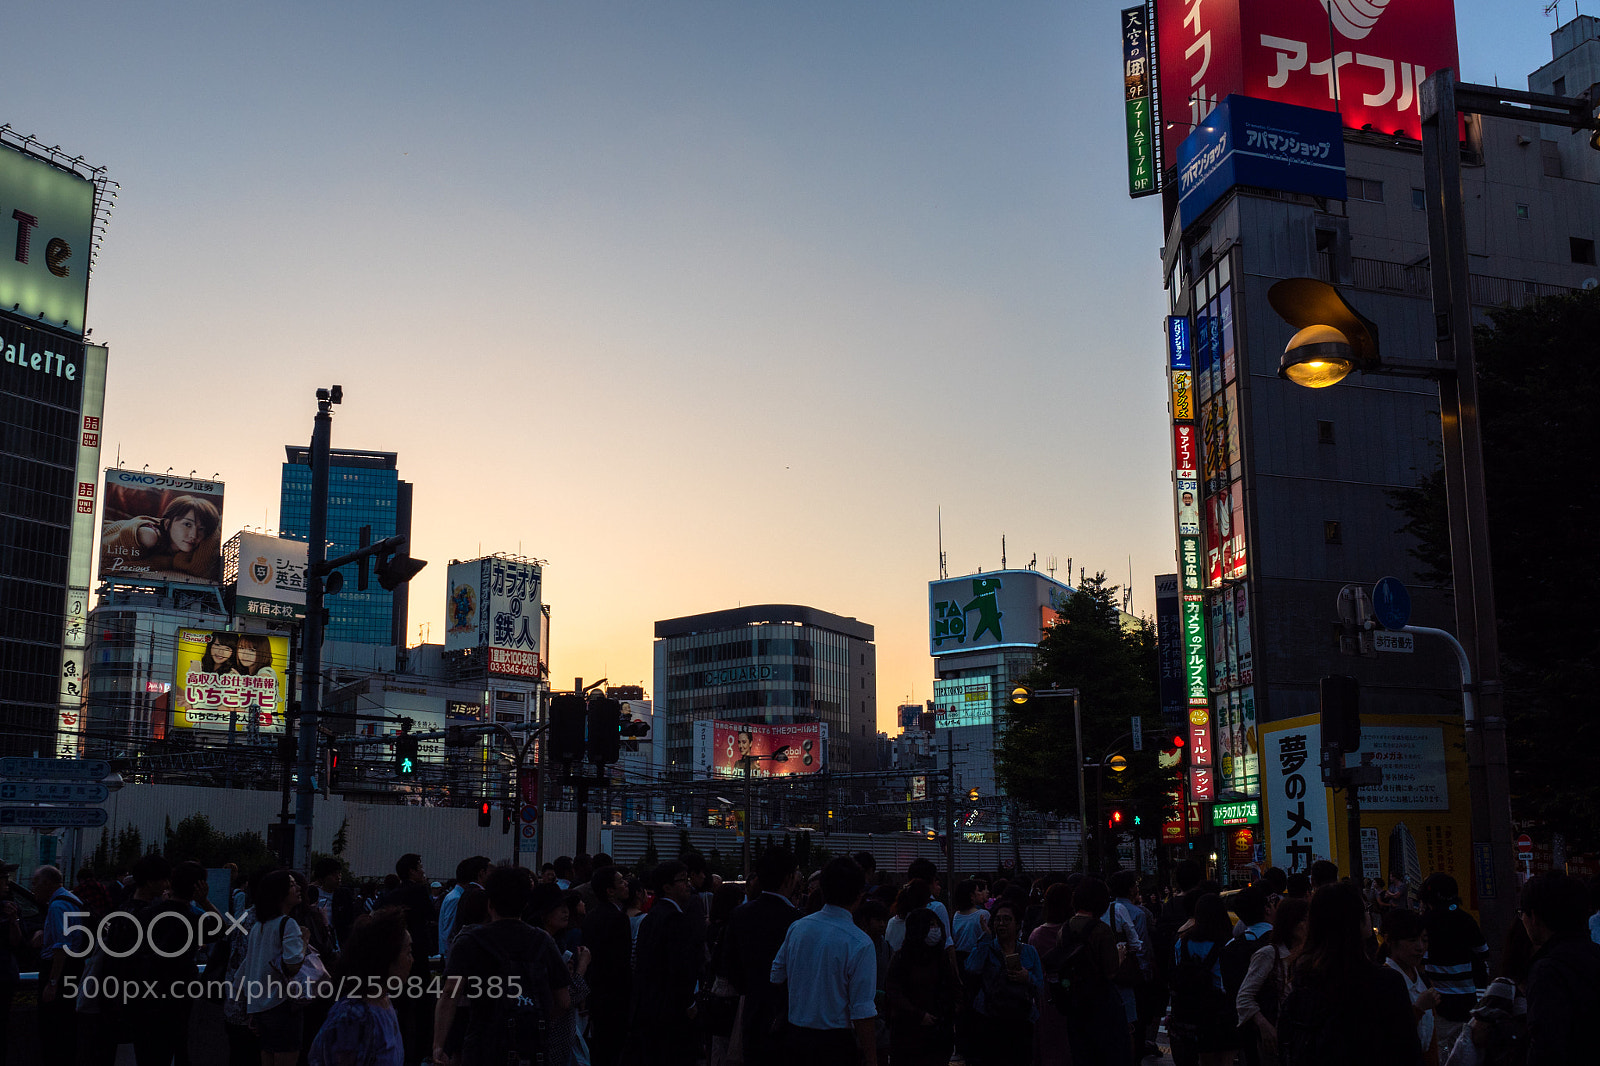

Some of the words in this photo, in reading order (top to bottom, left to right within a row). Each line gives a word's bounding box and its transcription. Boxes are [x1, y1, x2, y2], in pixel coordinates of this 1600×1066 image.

[1184, 0, 1218, 134] イフル
[1260, 34, 1426, 116] アイフル
[1130, 84, 1143, 97] 9F
[1133, 101, 1145, 174] ファームテーブル
[1246, 130, 1331, 159] アパマンショップ
[1181, 131, 1227, 191] アパマンショップ
[1134, 178, 1149, 191] 9F
[1176, 372, 1189, 418] ダーツグッズ
[1180, 435, 1191, 470] アイフル
[107, 545, 129, 558] Life
[131, 548, 141, 560] is
[1183, 539, 1199, 590] 宝石広場
[492, 564, 542, 602] カラオケ
[248, 603, 294, 621] 新宿本校
[511, 595, 522, 618] の
[935, 600, 964, 617] TA
[494, 613, 536, 651] 鉄人
[935, 617, 964, 637] NO
[1186, 602, 1206, 698] カメラのアルプス堂
[64, 660, 81, 697] 魚民
[187, 672, 275, 689] 高収入お仕事情報
[490, 664, 539, 676] 03-3345-6430
[186, 688, 275, 709] いちごナビ
[452, 703, 481, 716] コミック
[417, 744, 439, 754] OUSE
[1213, 803, 1258, 820] カメラのアルプス堂
